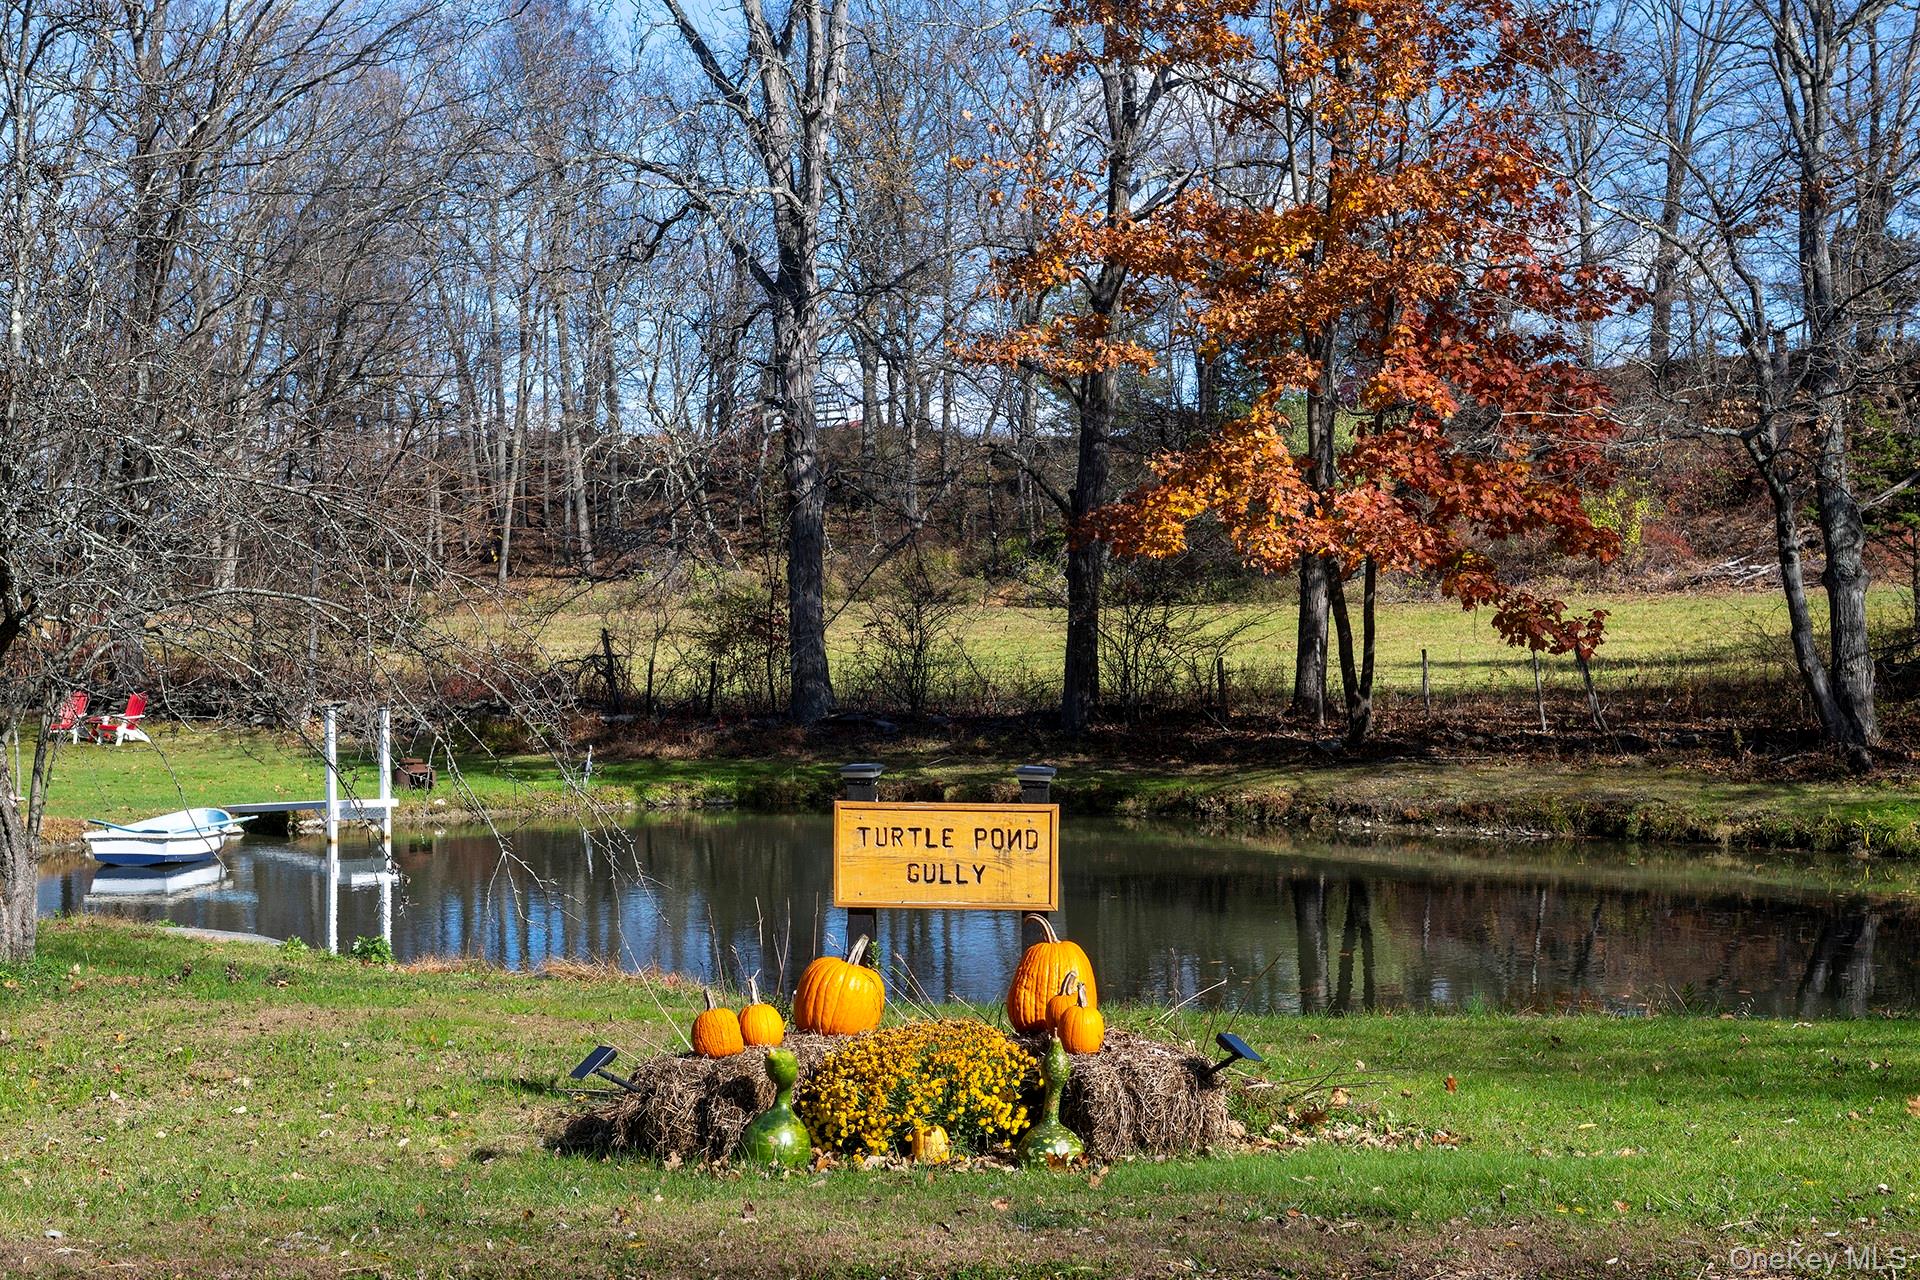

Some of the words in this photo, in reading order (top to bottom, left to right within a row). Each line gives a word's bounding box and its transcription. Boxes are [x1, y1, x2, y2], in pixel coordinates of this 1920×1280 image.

[856, 826, 955, 849] TURTLE
[973, 827, 1039, 851] POND
[906, 862, 986, 885] GULLY
